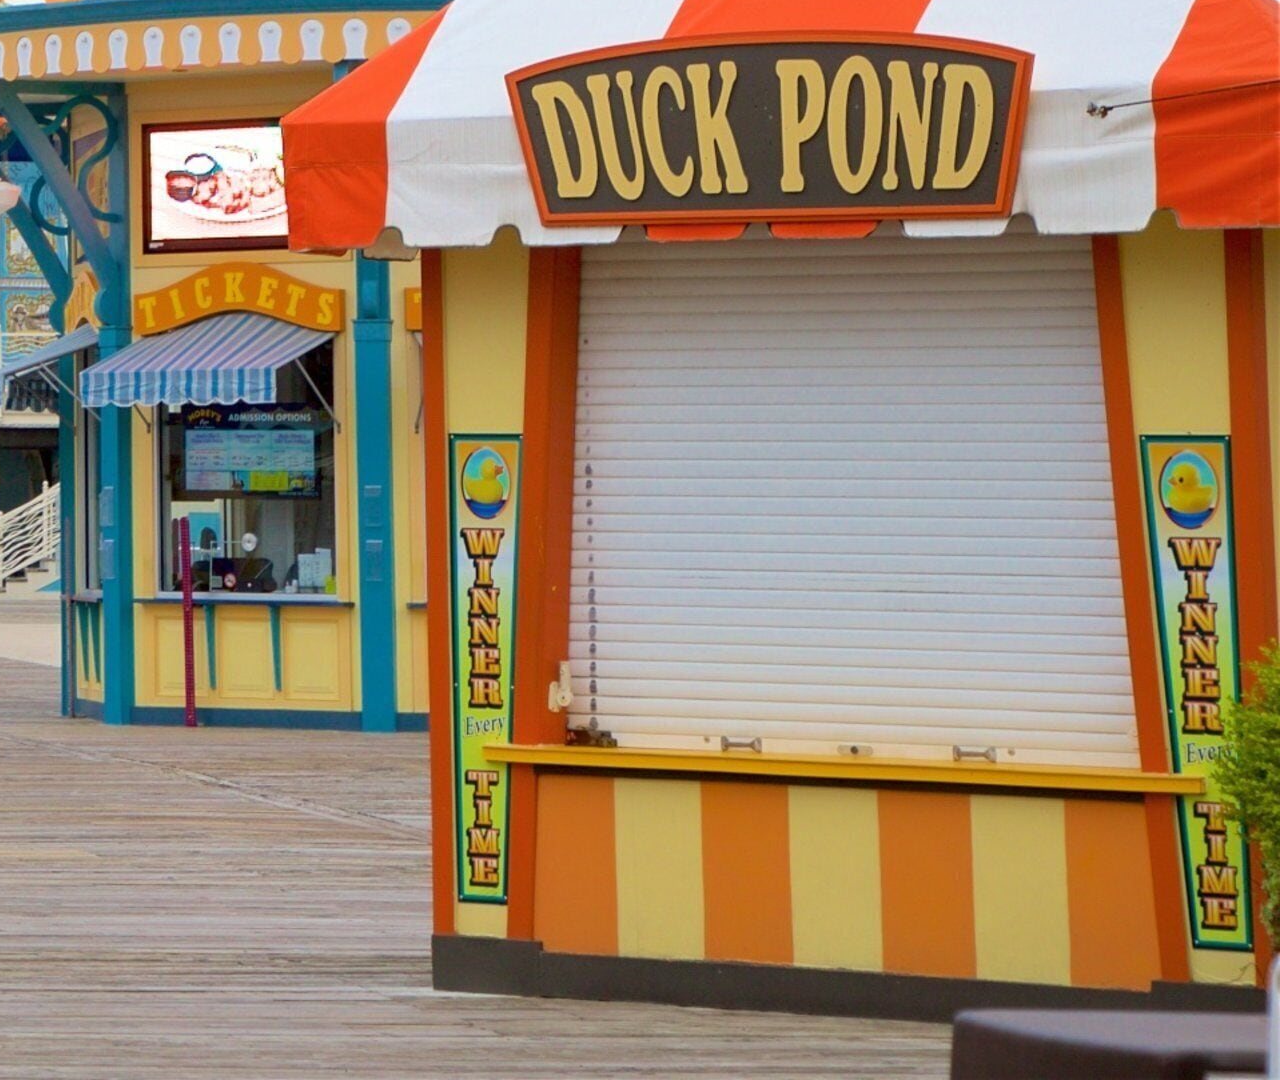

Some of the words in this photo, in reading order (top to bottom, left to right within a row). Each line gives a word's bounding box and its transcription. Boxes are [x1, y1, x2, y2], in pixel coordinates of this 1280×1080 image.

[531, 60, 749, 201] DUCK
[775, 55, 995, 194] POND
[138, 272, 336, 328] TICKETS
[228, 413, 274, 422] ADMISSION
[276, 413, 312, 422] OPTIONS
[460, 527, 504, 709] WINNER
[1168, 536, 1223, 735] WINNER
[463, 714, 506, 737] Every
[465, 770, 503, 887] TIME
[1193, 801, 1239, 930] TIME
